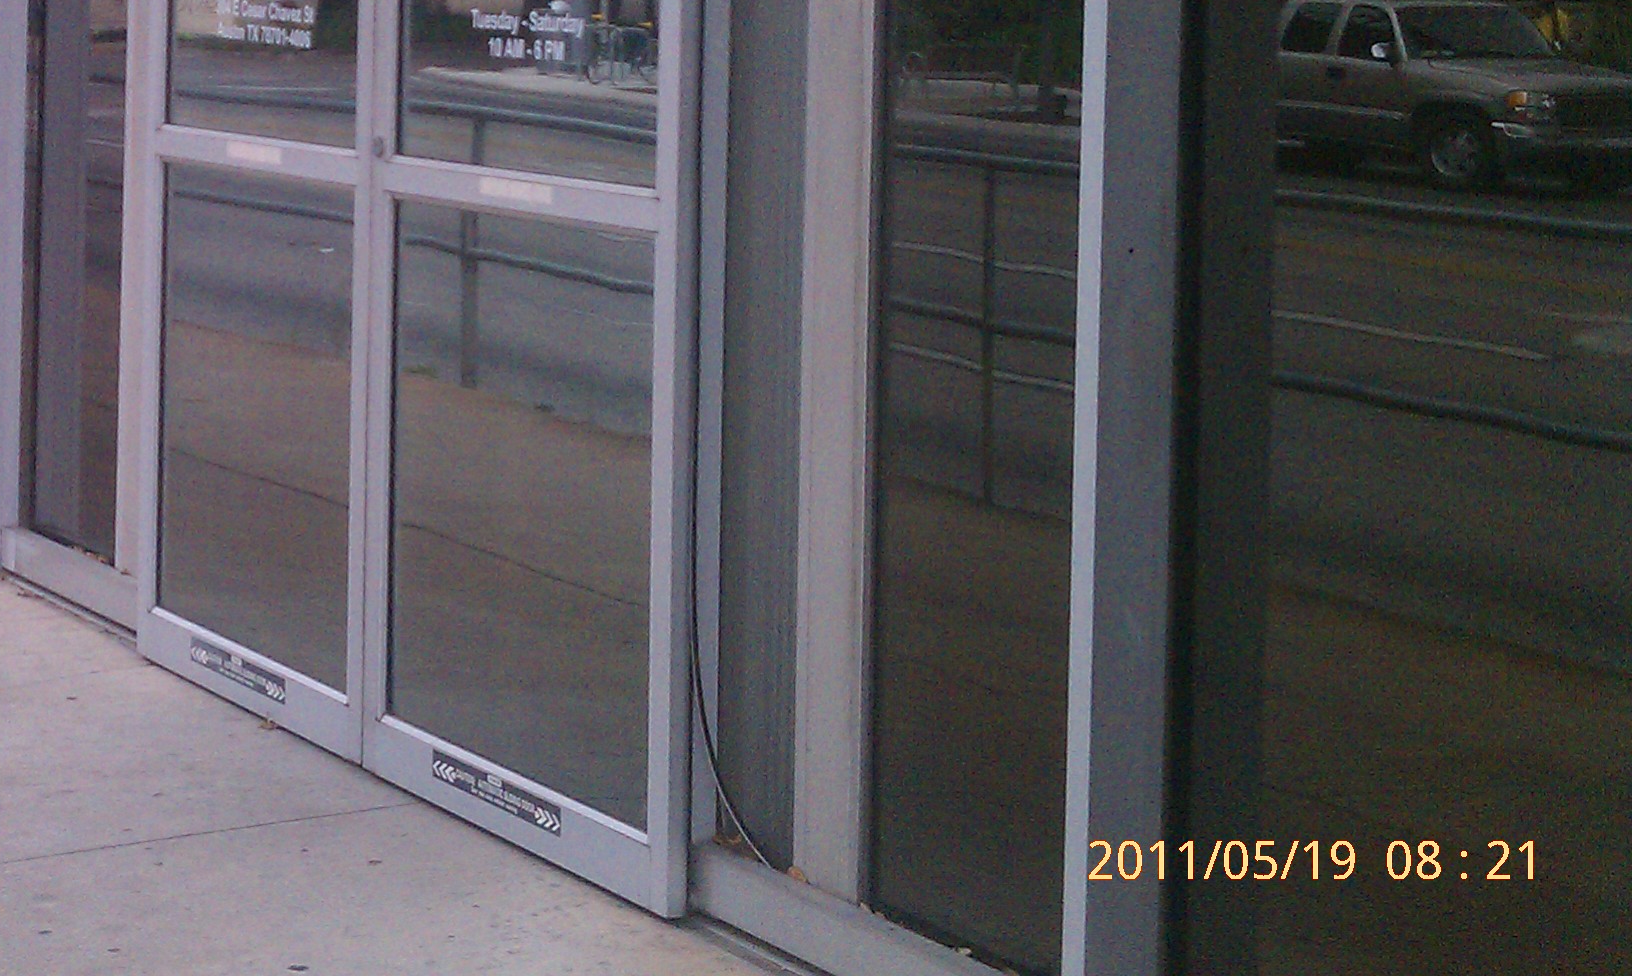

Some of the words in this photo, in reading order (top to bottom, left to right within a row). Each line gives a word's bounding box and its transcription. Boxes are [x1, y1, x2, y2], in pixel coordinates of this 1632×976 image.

[269, 2, 302, 23] Chavez
[470, 8, 520, 35] Tuesday
[529, 10, 585, 39] Saturday
[247, 24, 258, 42] TX
[488, 37, 502, 58] 10
[503, 37, 525, 59] AM
[533, 39, 543, 61] 6
[544, 39, 565, 61] PM
